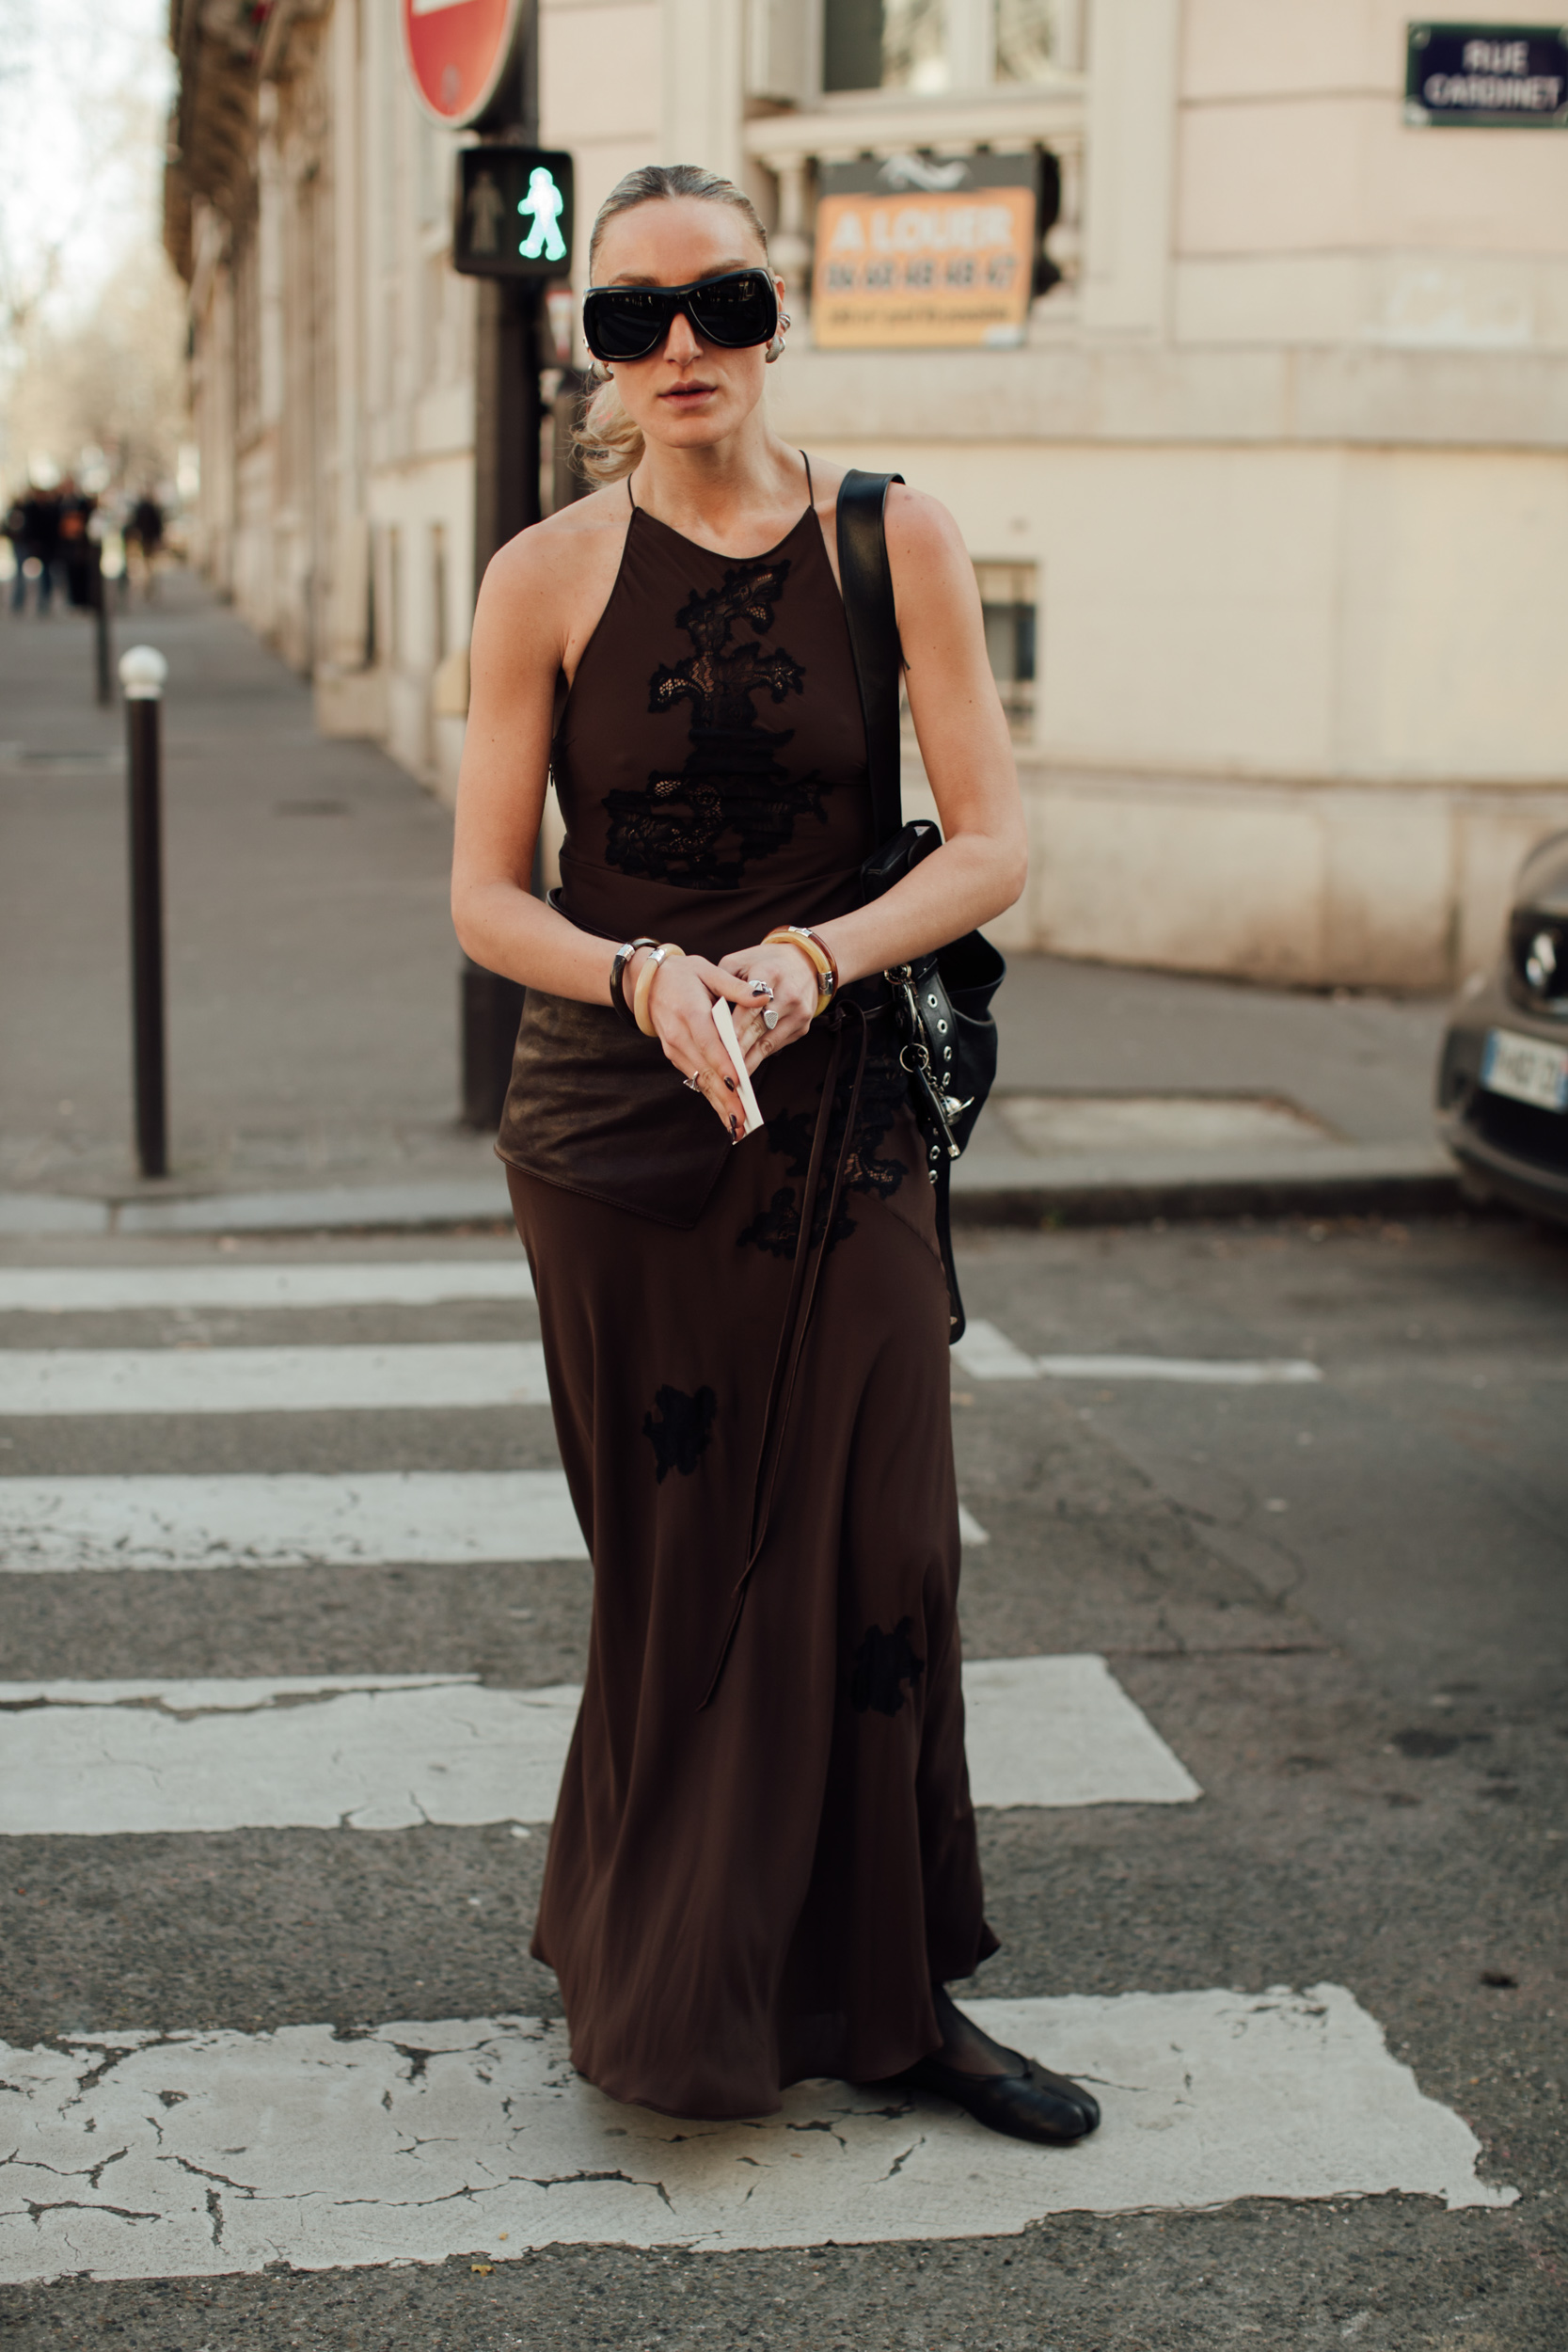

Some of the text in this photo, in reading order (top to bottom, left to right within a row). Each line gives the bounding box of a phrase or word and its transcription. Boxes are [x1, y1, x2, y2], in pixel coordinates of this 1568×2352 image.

[1463, 40, 1528, 74] RUE
[1424, 72, 1562, 110] CARDINET
[830, 205, 1013, 252] A LOUER
